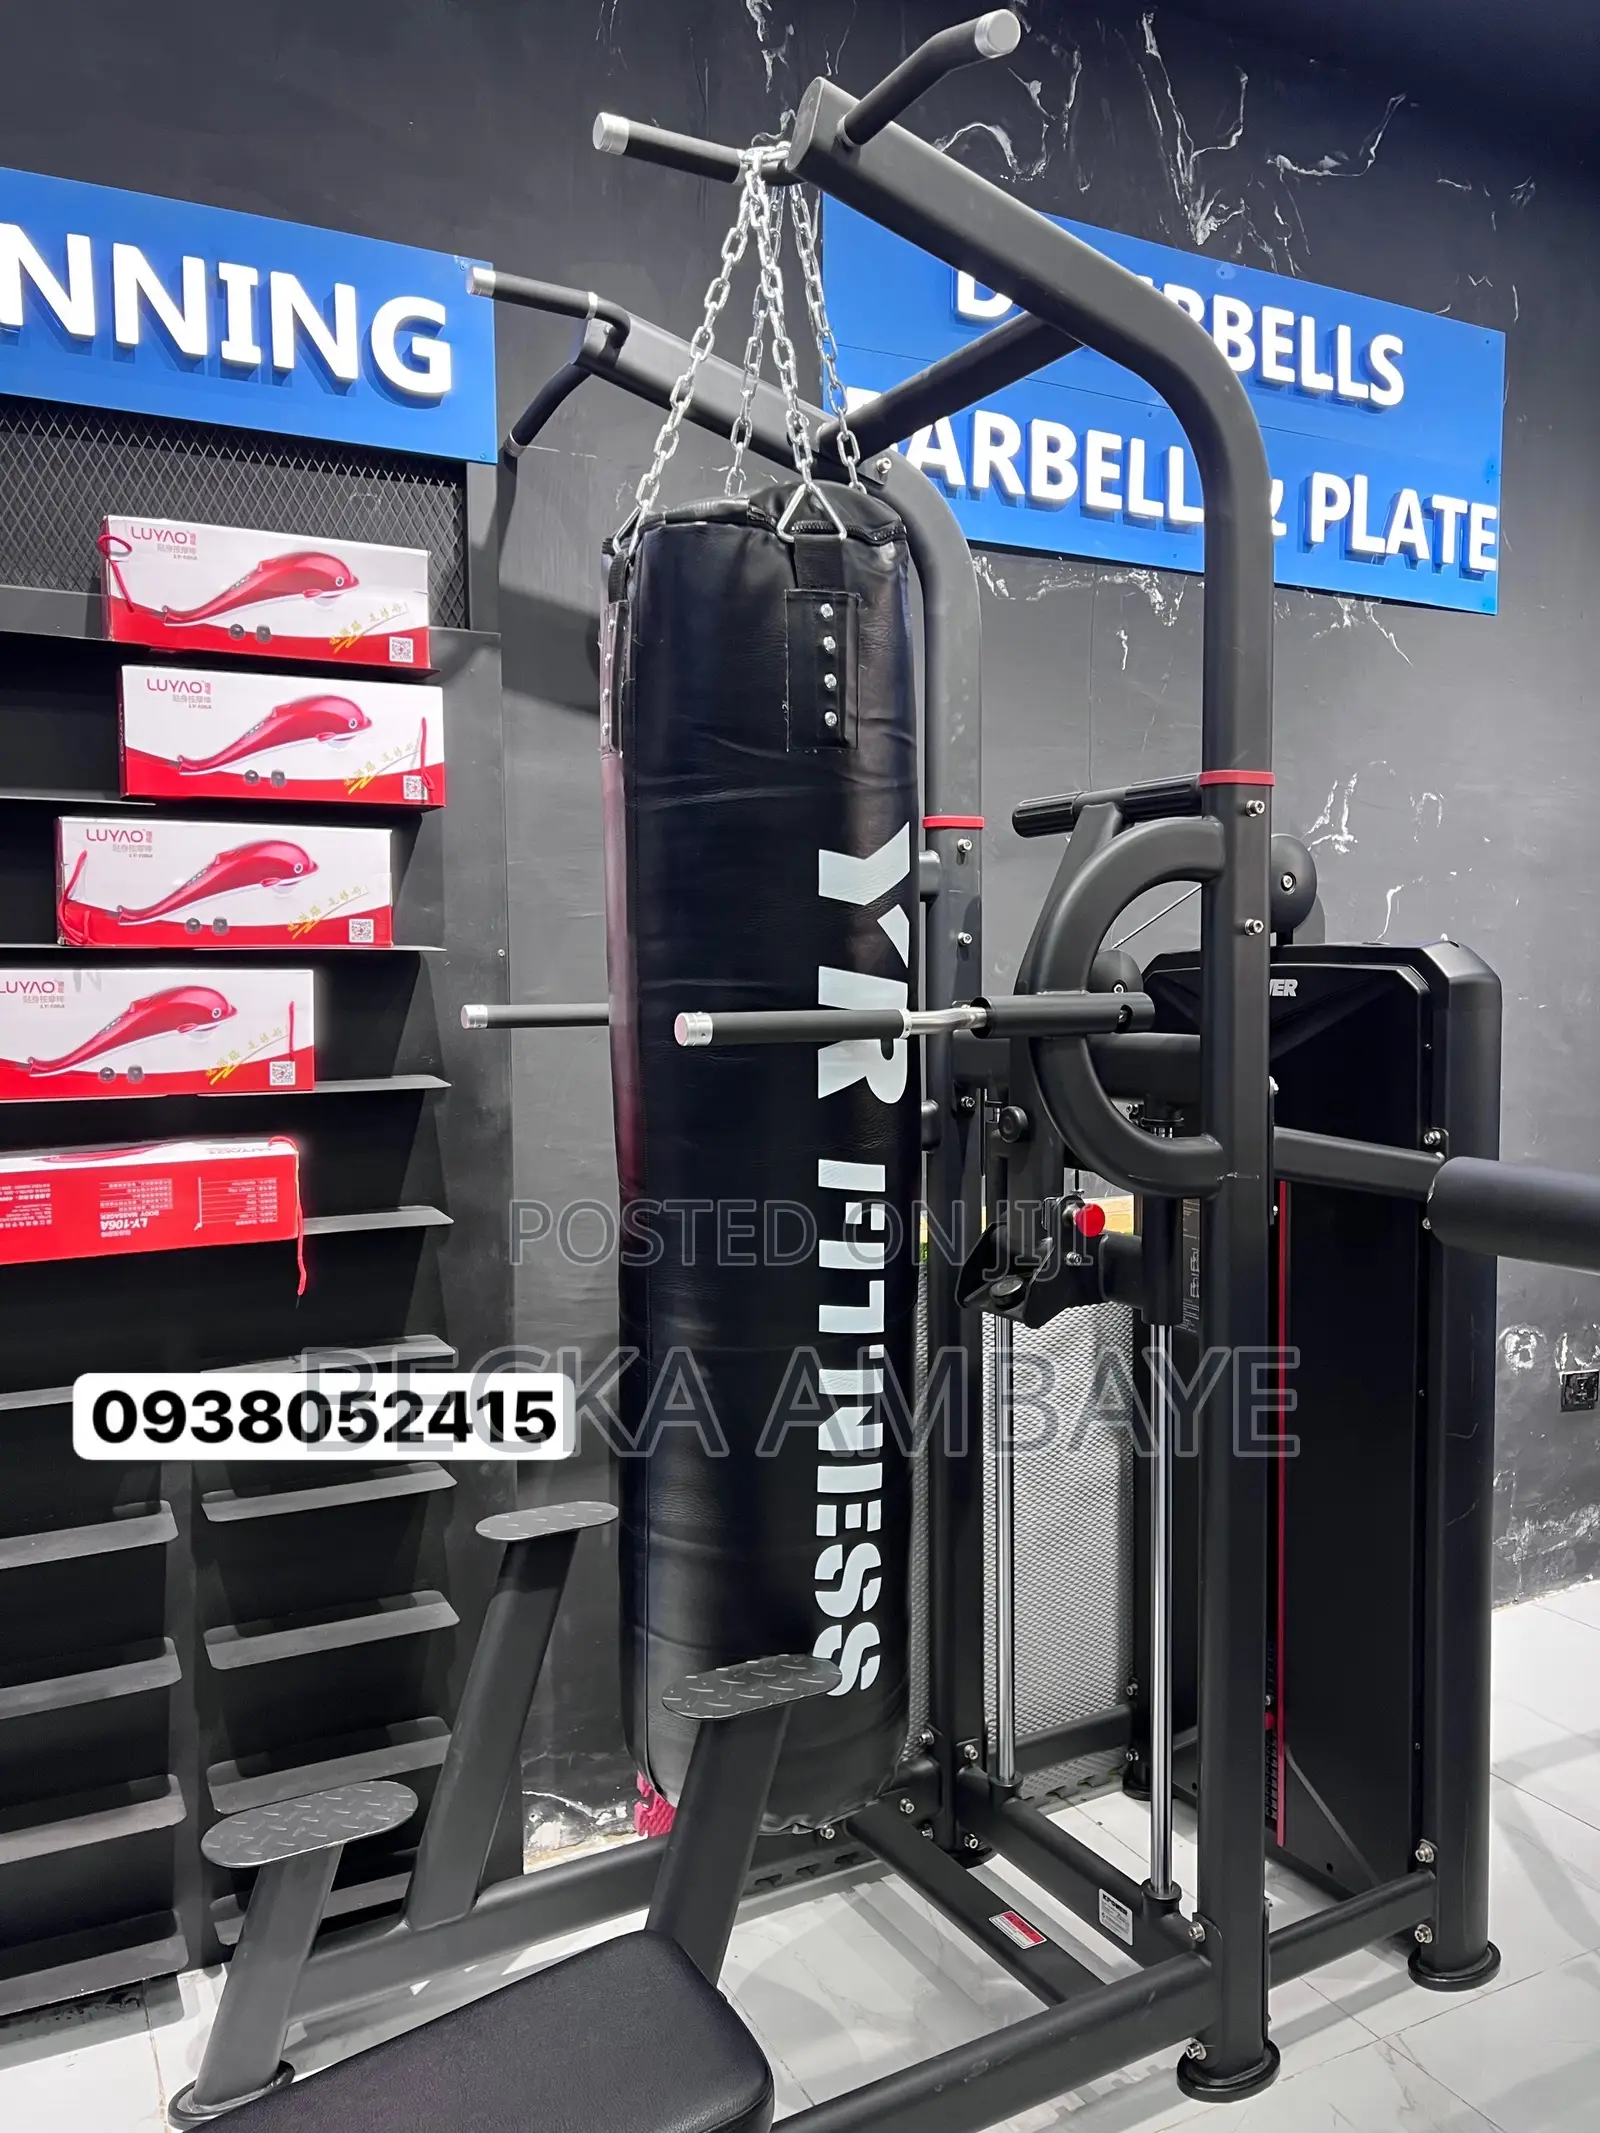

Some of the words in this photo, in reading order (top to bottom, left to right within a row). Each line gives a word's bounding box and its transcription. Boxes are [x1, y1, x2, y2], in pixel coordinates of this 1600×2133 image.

[1310, 471, 1497, 572] PLATE
[131, 526, 187, 545] LUYAO
[147, 678, 202, 694] LUYAO
[86, 829, 143, 843] LUYAO
[1270, 979, 1298, 997] ER
[100, 1218, 148, 1230] LY-106A
[811, 1159, 886, 1696] FITNESS
